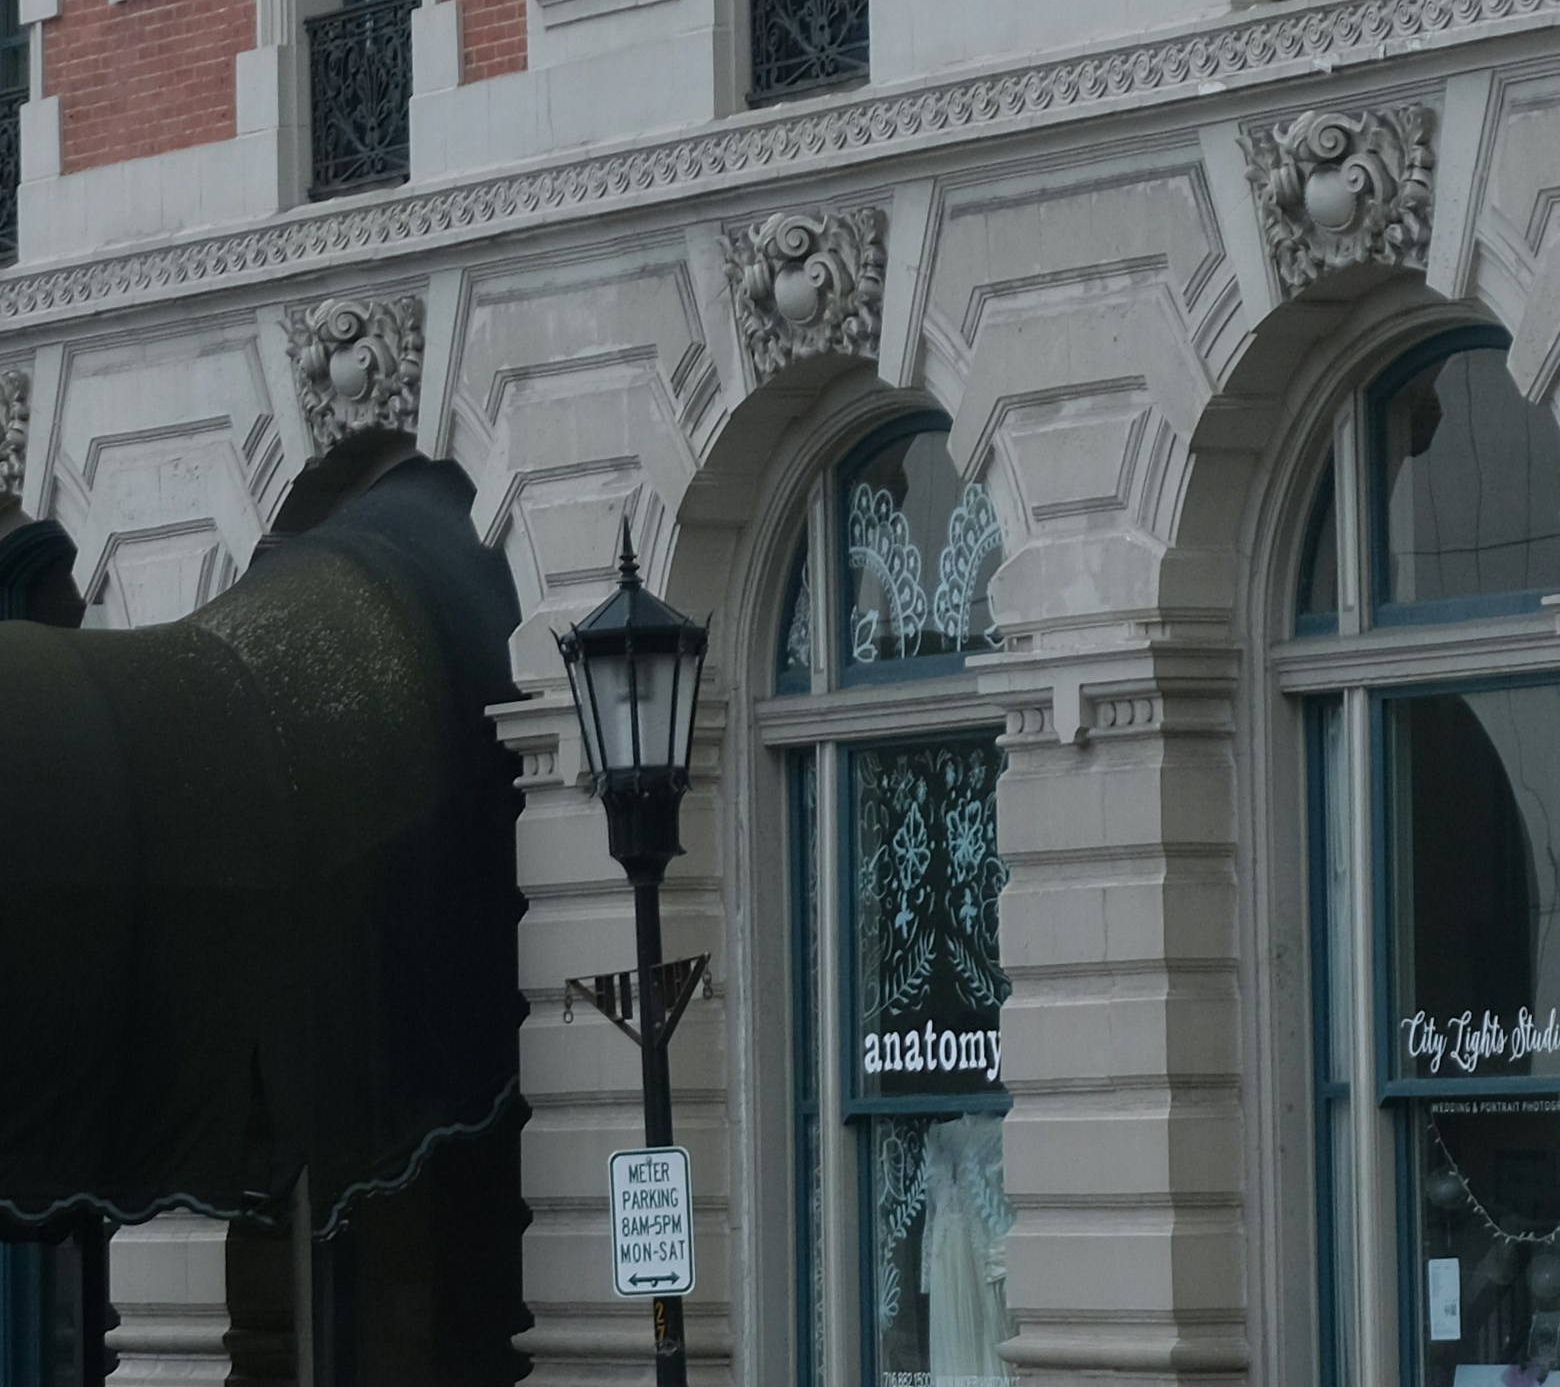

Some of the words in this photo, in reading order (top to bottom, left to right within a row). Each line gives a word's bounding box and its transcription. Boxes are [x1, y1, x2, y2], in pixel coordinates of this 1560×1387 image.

[864, 1019, 1002, 1082] anatomy
[1400, 1010, 1448, 1074] City
[1448, 1010, 1508, 1073] Lights
[1431, 1102, 1471, 1113] WEDDING
[1480, 1101, 1520, 1113] PORTRAIT
[628, 1162, 670, 1184] METER
[622, 1187, 679, 1211] PARKING
[621, 1213, 683, 1238] 8AM-5PM
[620, 1239, 686, 1264] MON-SAT
